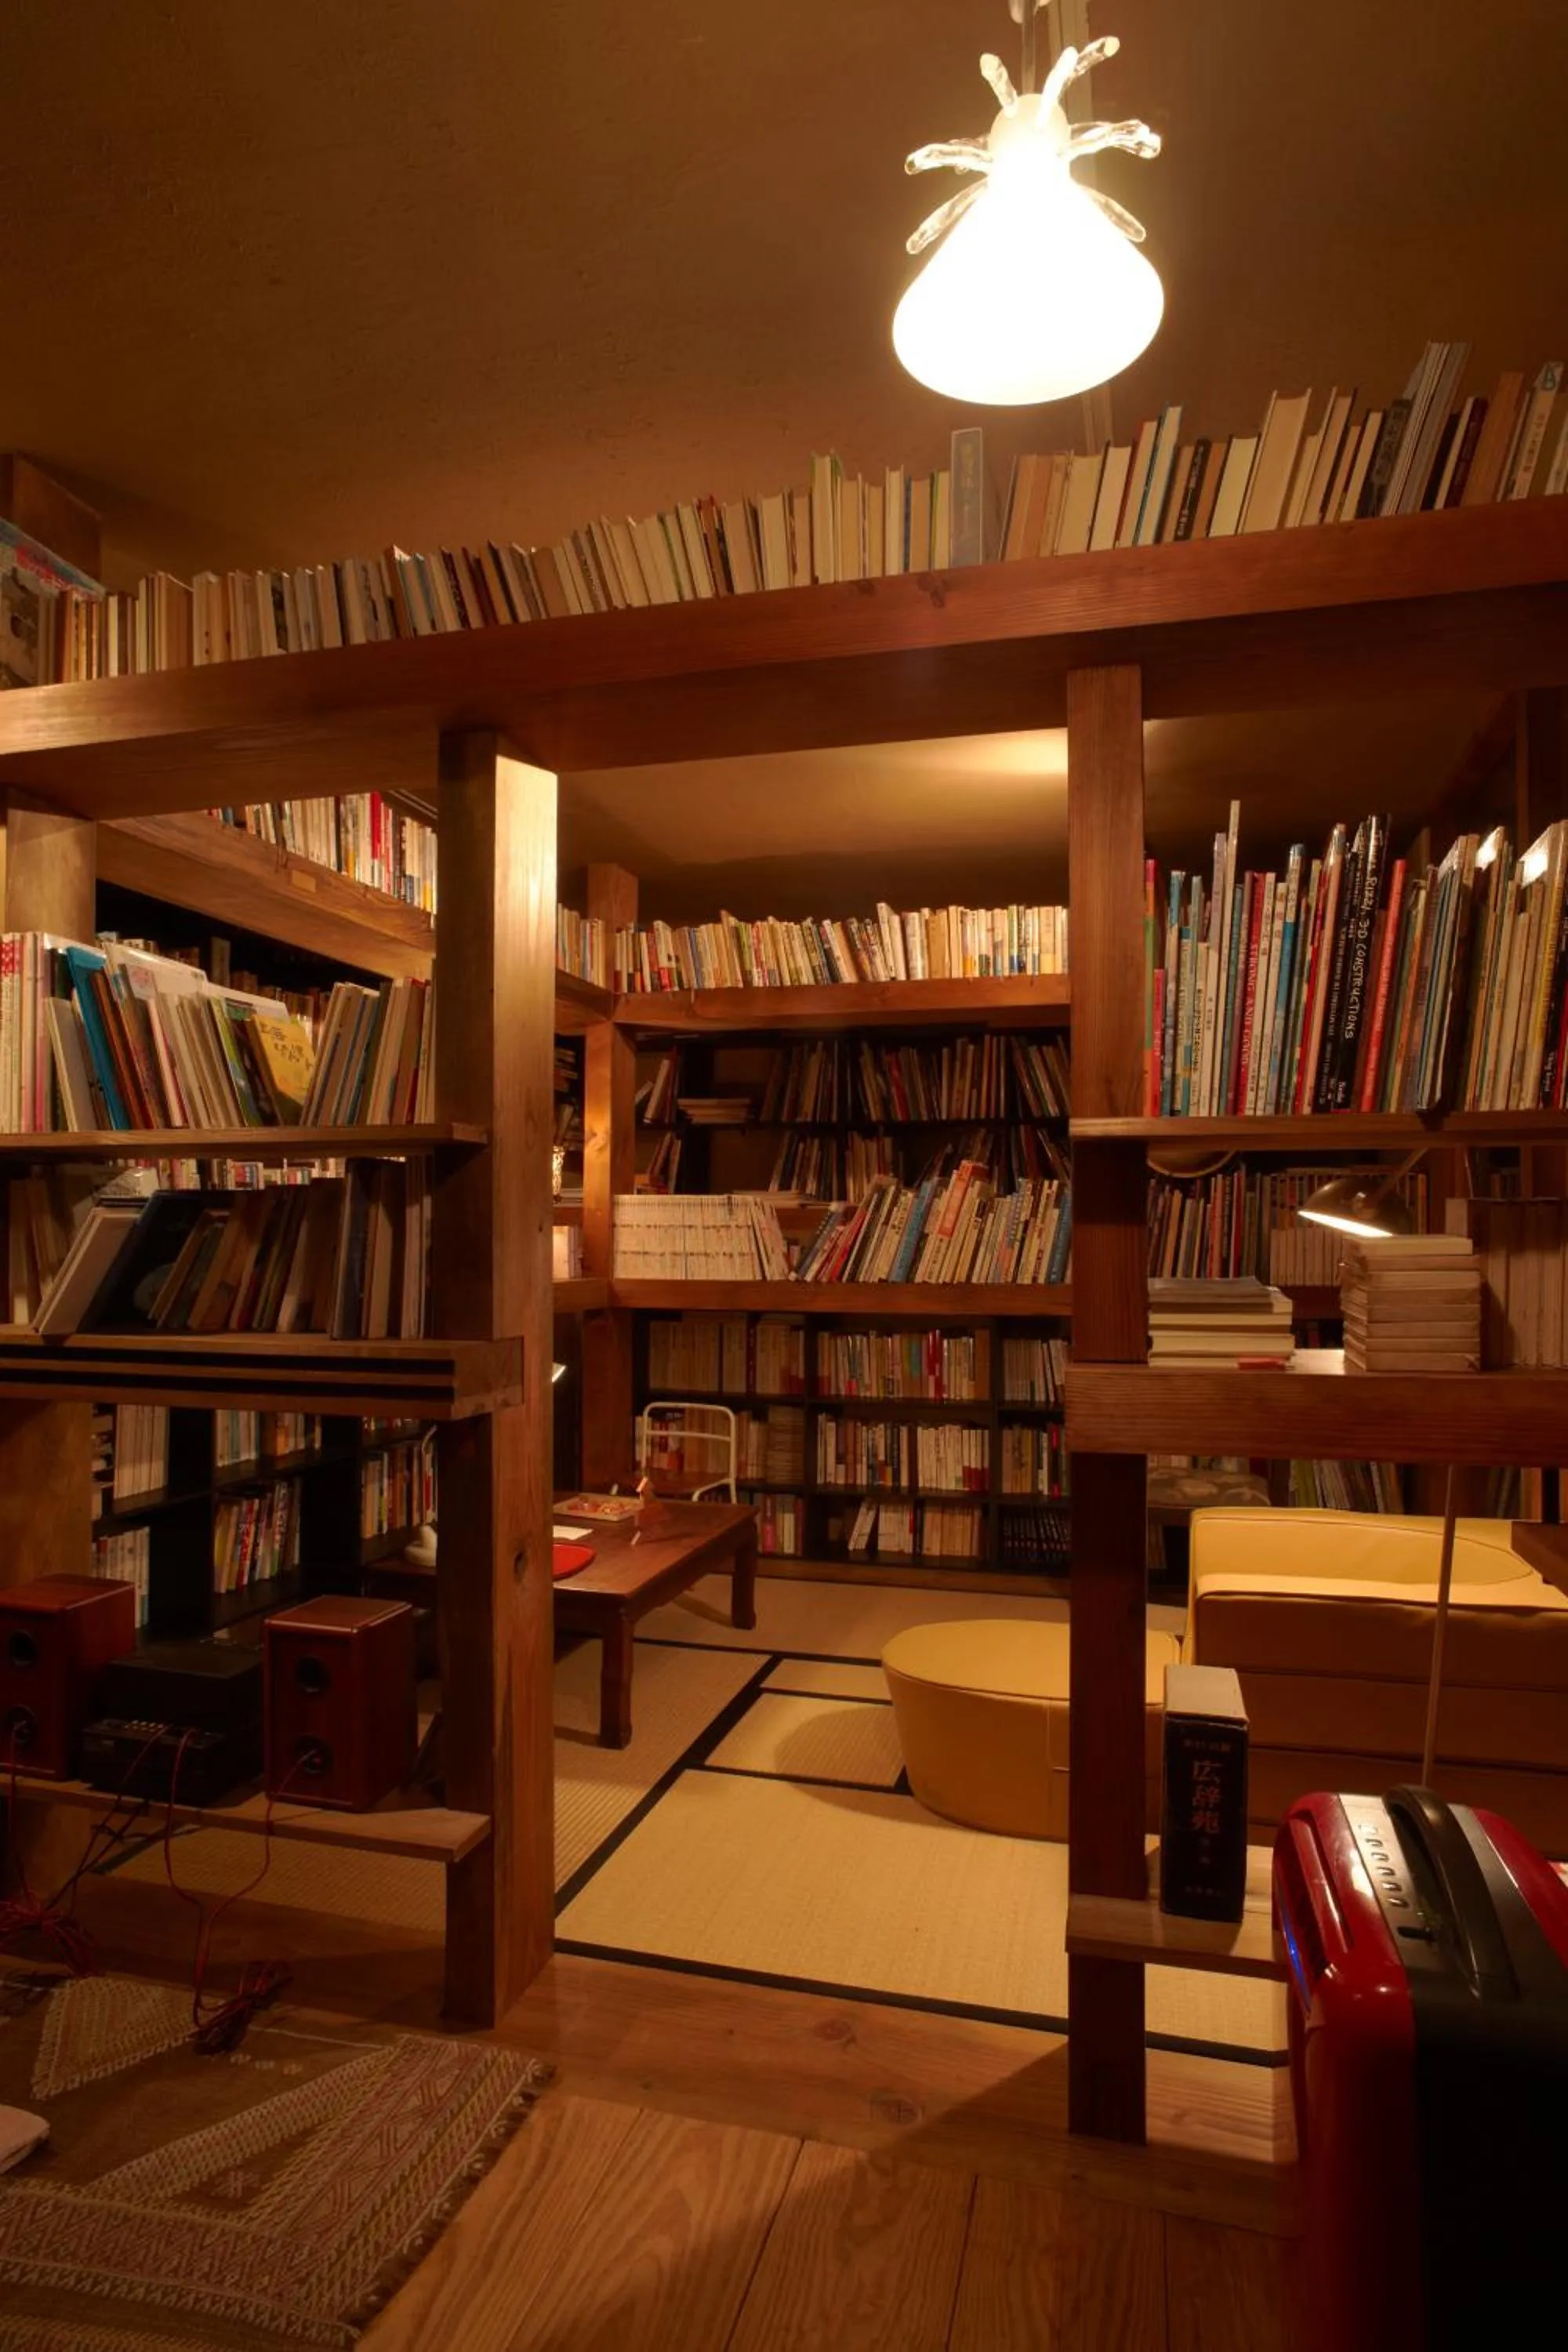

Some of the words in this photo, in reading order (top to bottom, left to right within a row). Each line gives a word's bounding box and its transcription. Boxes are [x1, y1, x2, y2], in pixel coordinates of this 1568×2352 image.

[1345, 942, 1367, 1040] CONSTRUCTIONS
[1191, 1759, 1223, 1835] 広辞苑
